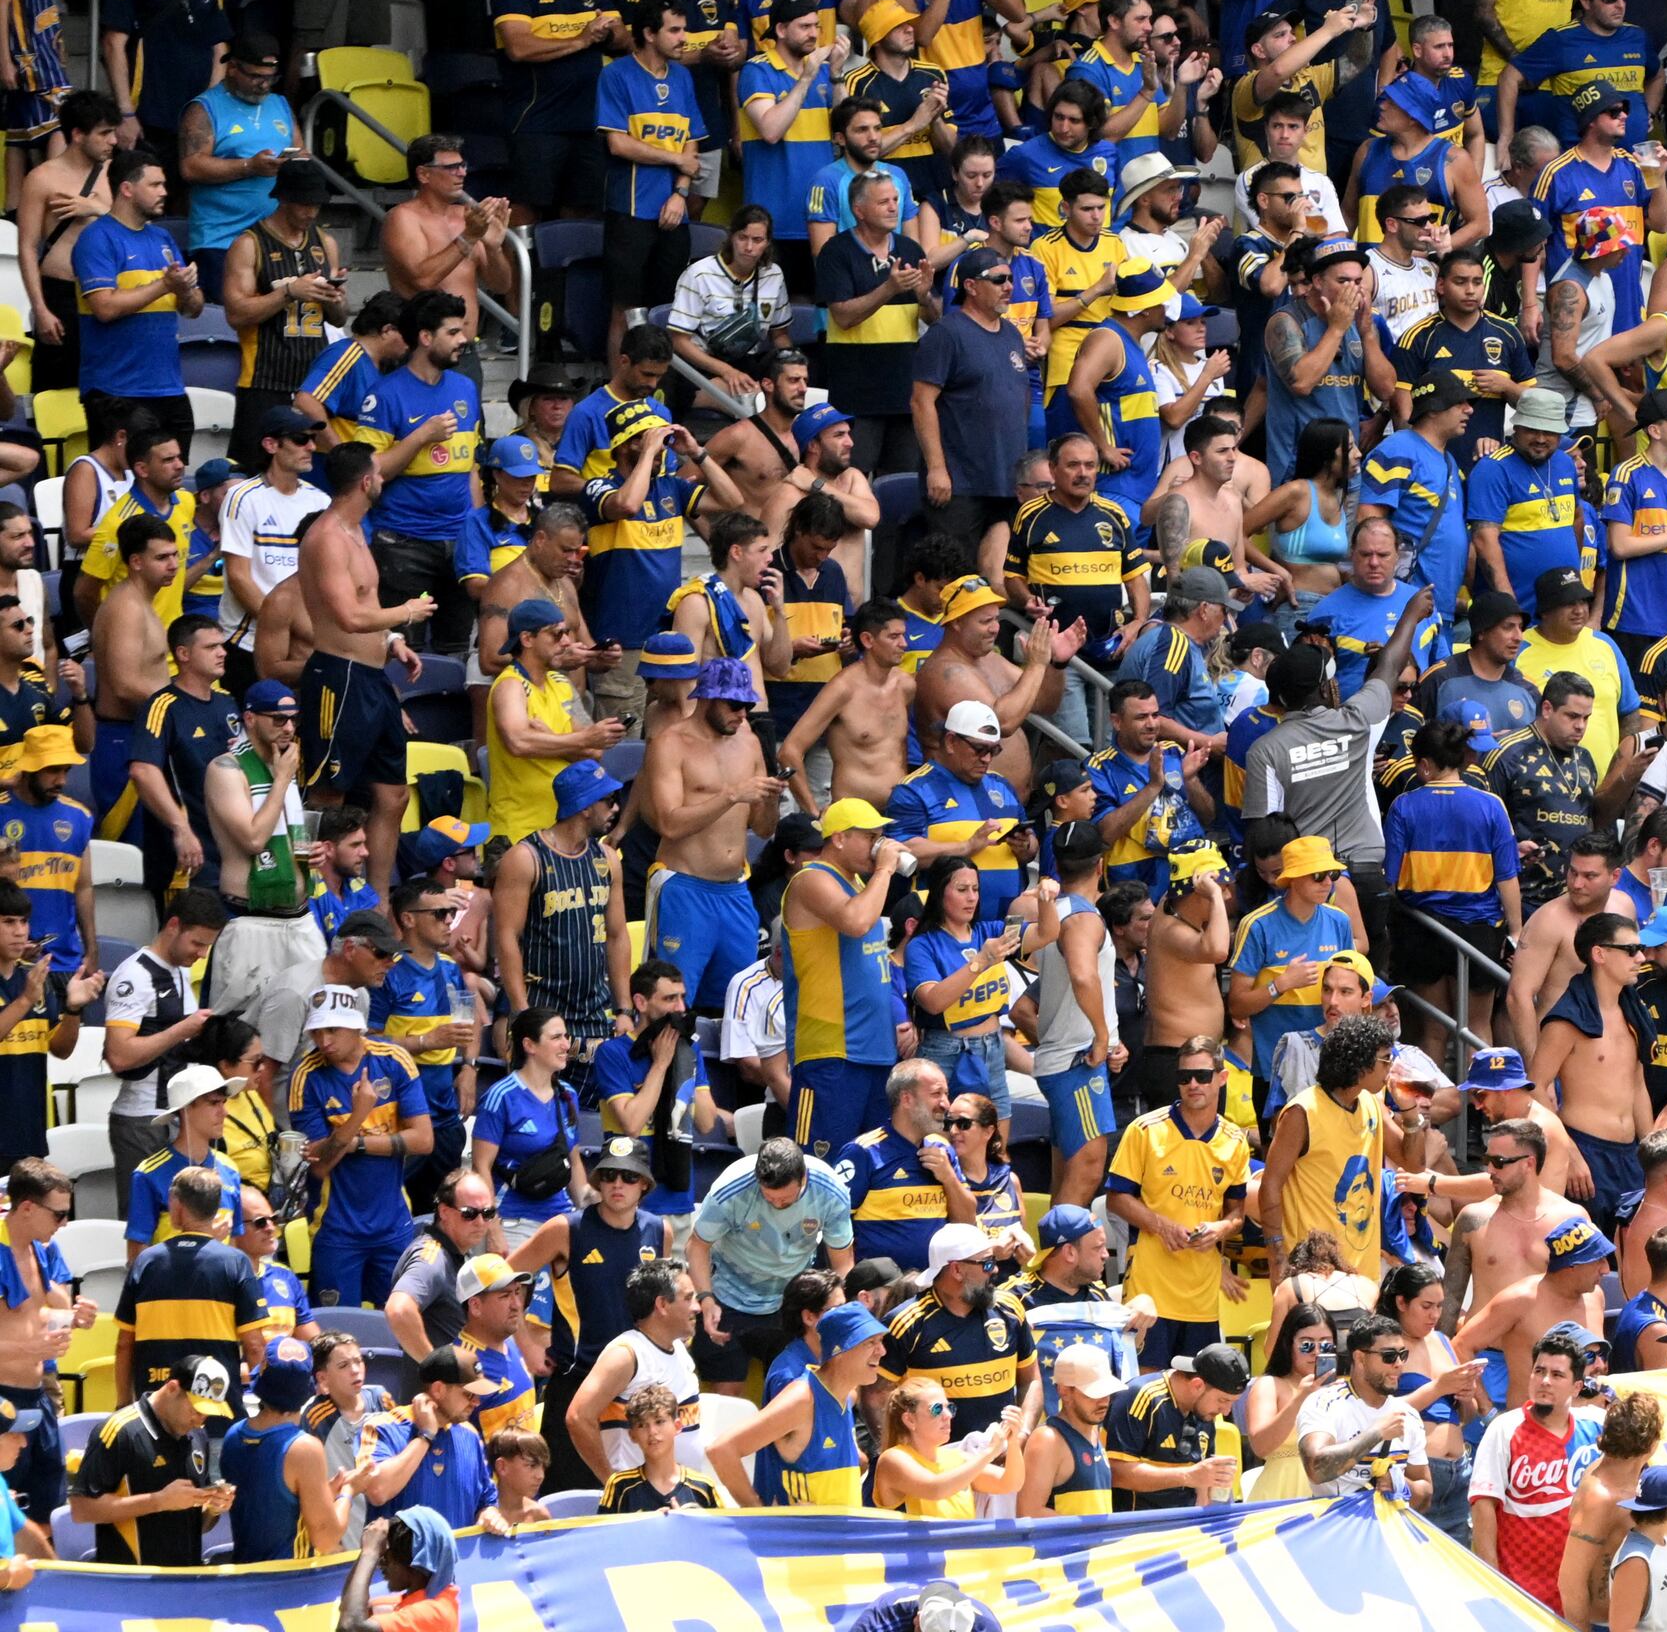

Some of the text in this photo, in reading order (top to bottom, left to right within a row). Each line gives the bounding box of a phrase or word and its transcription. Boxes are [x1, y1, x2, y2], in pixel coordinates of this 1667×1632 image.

[1594, 71, 1638, 86] QATAR
[1571, 84, 1601, 113] 1905
[1384, 296, 1419, 320] BOCA
[282, 299, 324, 339] 12
[452, 445, 469, 462] LG
[264, 551, 298, 567] bets
[1048, 561, 1114, 577] betsson
[1287, 735, 1352, 766] BEST
[542, 891, 585, 919] BOCA
[1489, 1056, 1505, 1071] 12
[902, 1192, 946, 1208] QATAR
[1170, 1182, 1214, 1202] QATAR
[1552, 1224, 1598, 1257] BOCA
[940, 1370, 1010, 1390] betsson
